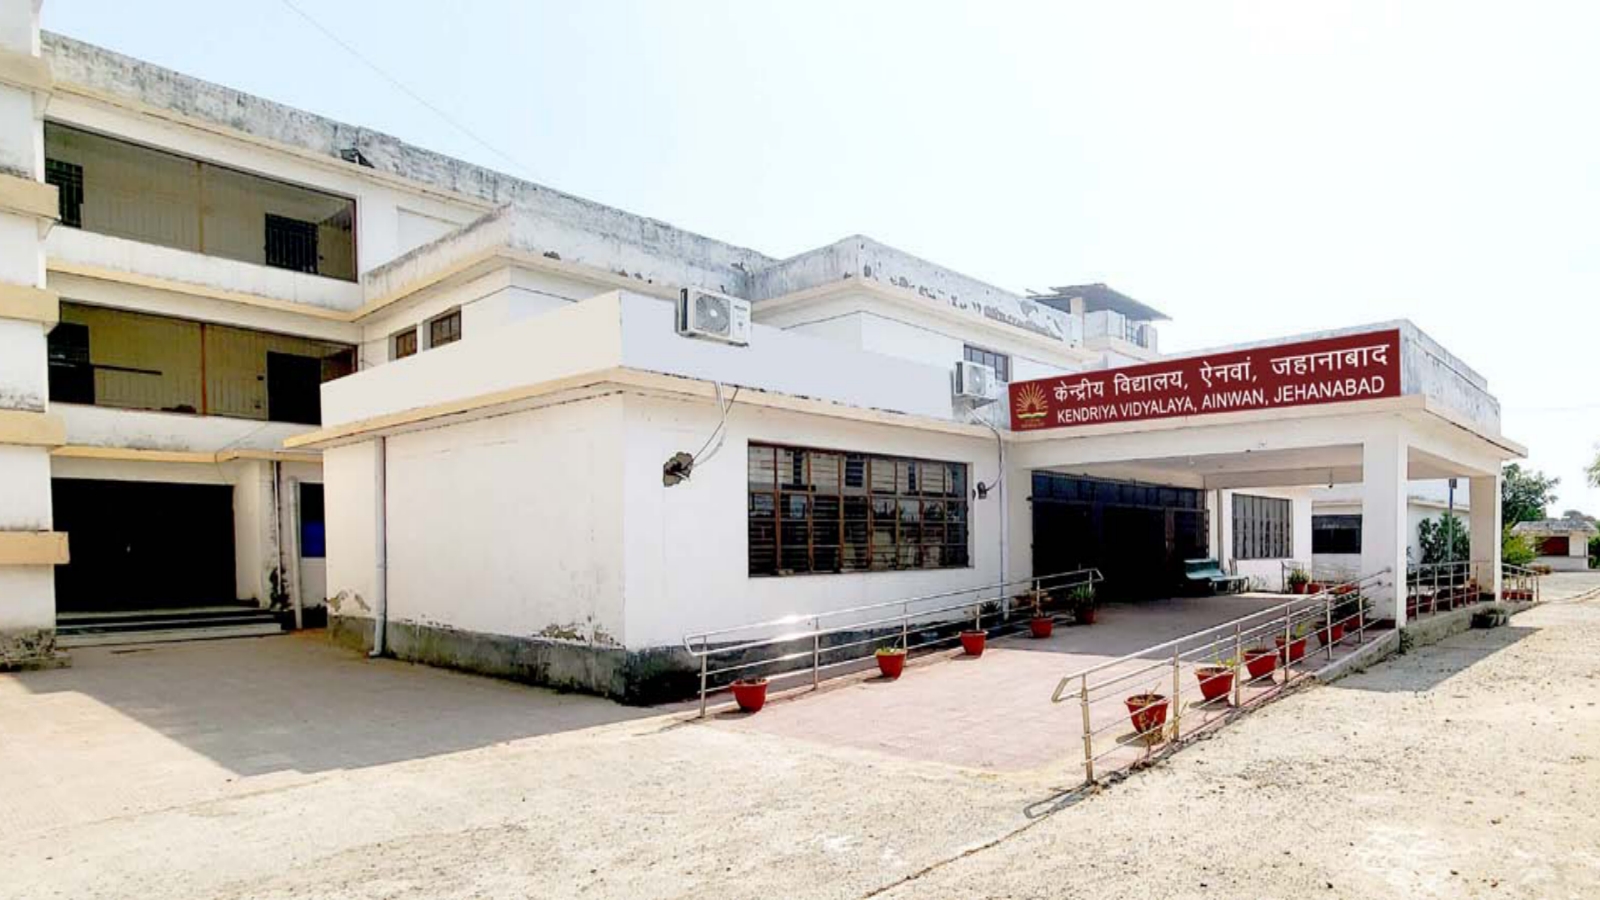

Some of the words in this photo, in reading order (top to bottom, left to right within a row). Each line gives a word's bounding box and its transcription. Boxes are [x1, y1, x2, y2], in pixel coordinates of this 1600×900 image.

[1053, 378, 1104, 402] केन्द्रीय
[1114, 371, 1188, 396] विद्यालय,
[1200, 356, 1257, 388] ऐनवां,
[1270, 344, 1390, 376] जहानाबाद
[1057, 404, 1118, 423] KENDRIYA
[1120, 396, 1198, 417] VIDYALAYA,
[1202, 388, 1269, 410] AINWAN,
[1274, 375, 1385, 403] JEHANABAD
